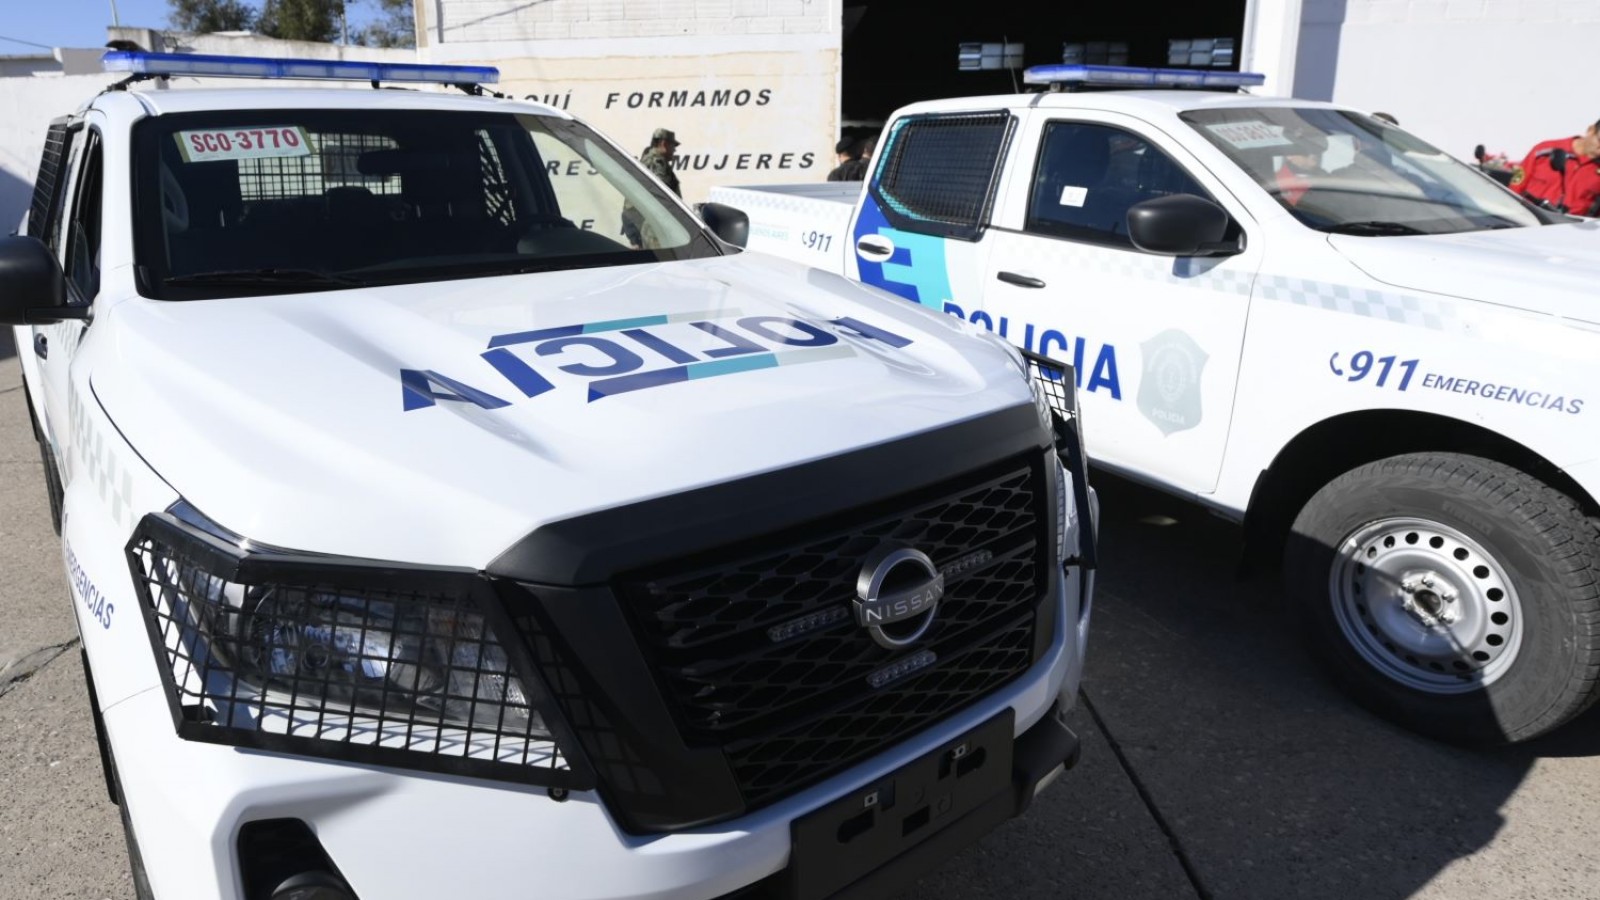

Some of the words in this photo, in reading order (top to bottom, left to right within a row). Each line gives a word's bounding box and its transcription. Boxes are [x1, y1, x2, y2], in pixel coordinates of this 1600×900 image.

[507, 89, 573, 110] UÍ
[605, 88, 772, 110] FORMAMOS
[669, 152, 815, 171] MUJERES
[808, 230, 833, 253] 911
[1347, 350, 1420, 392] 911
[1422, 373, 1585, 414] EMERGENCIAS
[866, 583, 943, 622] NISSAN
